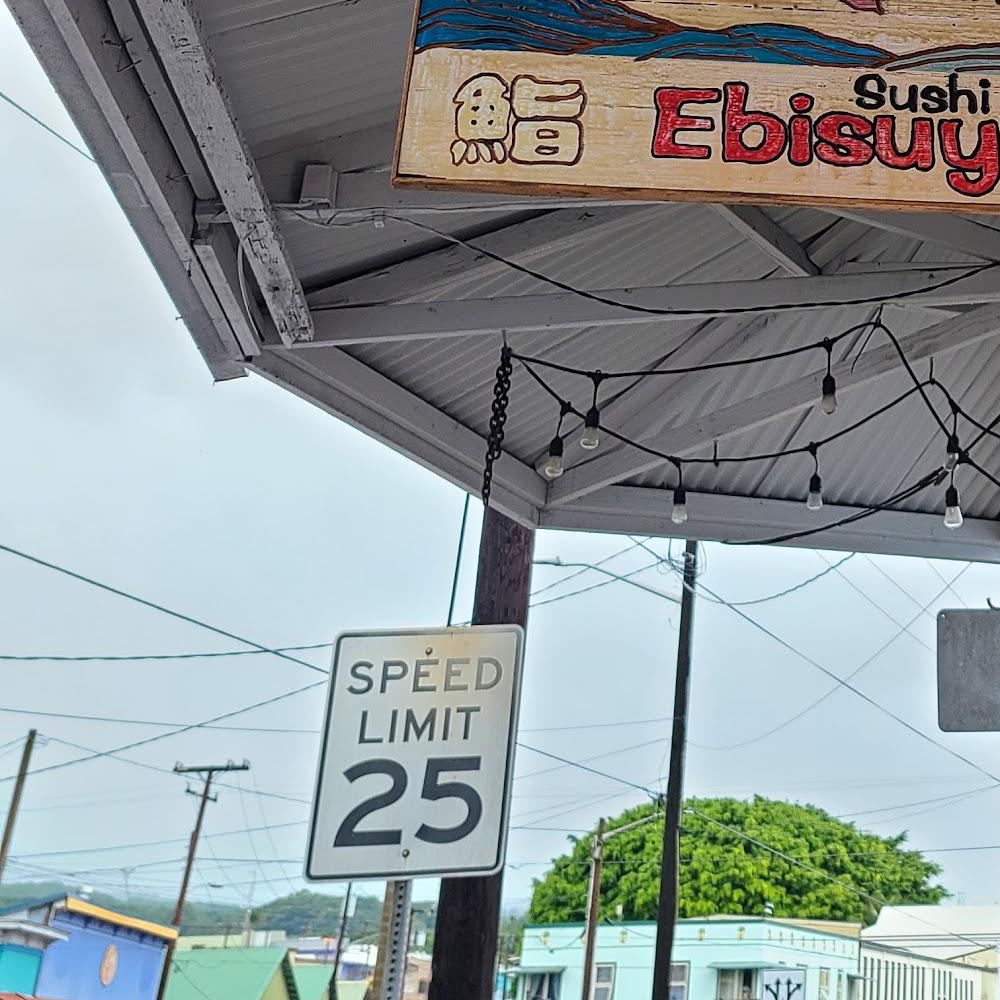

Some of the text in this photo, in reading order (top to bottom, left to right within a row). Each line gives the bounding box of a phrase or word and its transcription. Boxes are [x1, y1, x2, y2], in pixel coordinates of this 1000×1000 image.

[853, 73, 991, 115] Sushi
[346, 656, 503, 695] SPEED
[357, 705, 482, 744] LIMIT
[332, 755, 484, 848] 25
